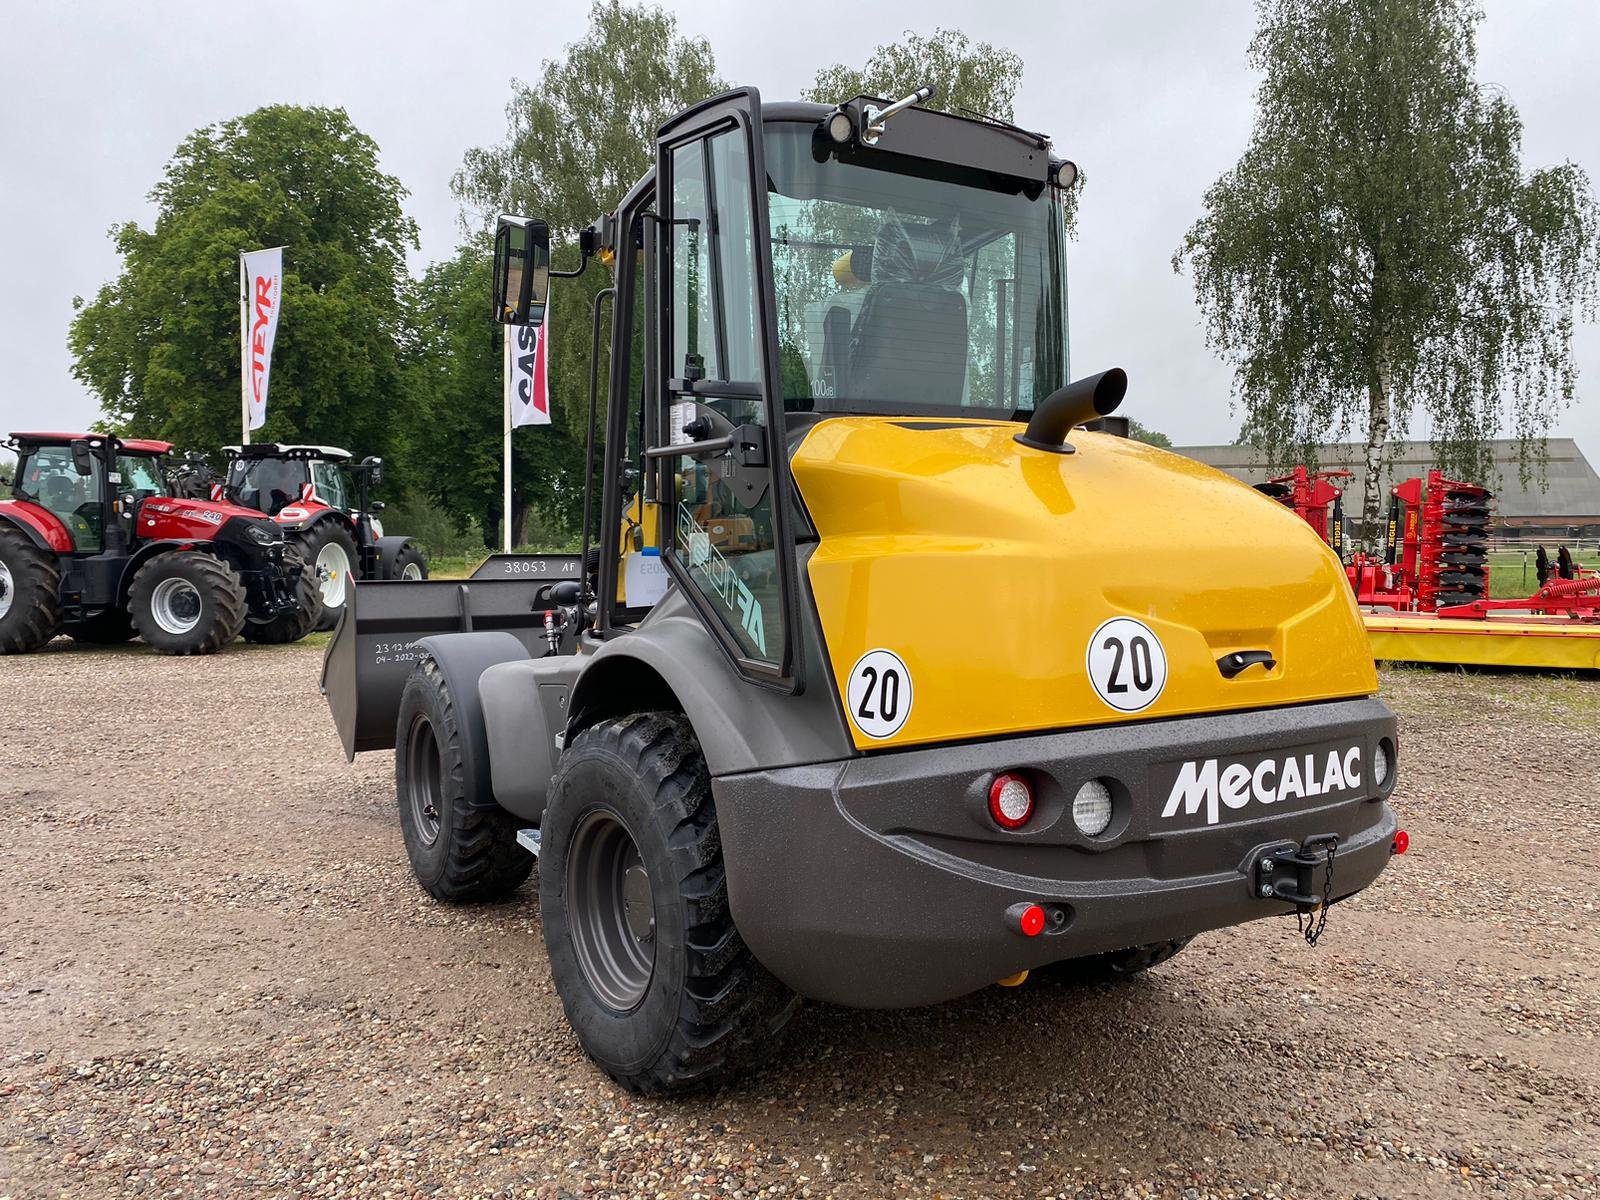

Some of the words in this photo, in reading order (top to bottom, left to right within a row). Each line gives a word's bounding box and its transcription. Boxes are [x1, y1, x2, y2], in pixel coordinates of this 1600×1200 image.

[517, 325, 537, 406] CAS
[203, 510, 223, 521] 240
[1388, 520, 1397, 548] ZIEGLER
[504, 561, 547, 574] 38053
[562, 562, 576, 572] AF
[1103, 635, 1154, 694] 20
[858, 665, 899, 722] 20
